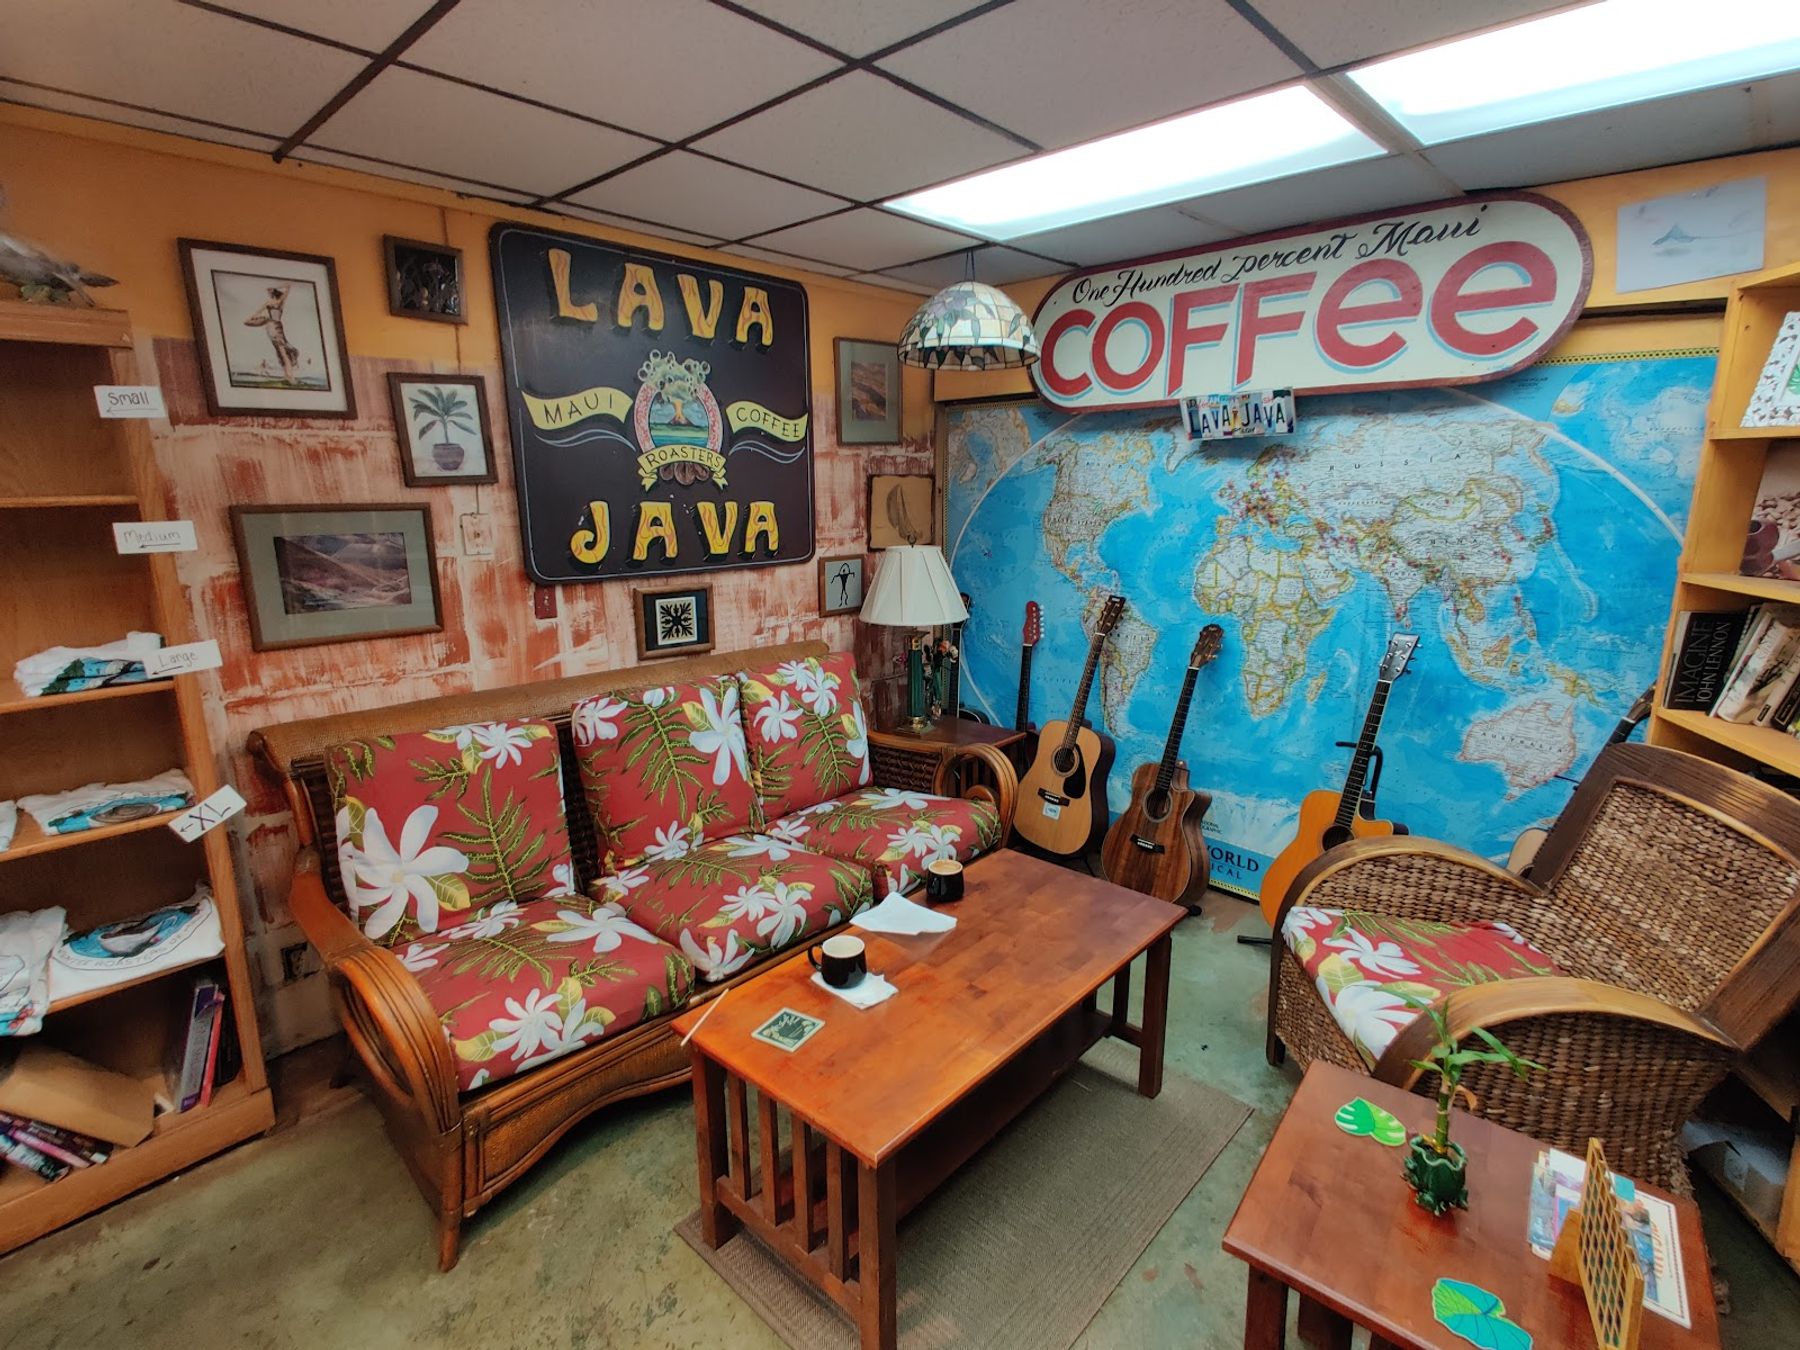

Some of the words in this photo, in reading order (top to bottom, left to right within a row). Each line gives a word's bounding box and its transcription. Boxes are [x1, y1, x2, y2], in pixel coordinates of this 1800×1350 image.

[1072, 271, 1114, 303] One
[1104, 257, 1222, 306] Hundred
[1220, 232, 1358, 285] percent
[1356, 204, 1489, 259] Maui
[548, 248, 775, 348] LAVA
[107, 391, 150, 406] Small
[543, 395, 613, 425] MAUI
[735, 406, 802, 438] COFFEE
[1188, 404, 1231, 434] LAVA
[1241, 402, 1285, 429] JAVA
[645, 447, 723, 467] ROASTERS
[570, 500, 780, 565] JAVA
[158, 651, 199, 668] Large
[1675, 618, 1712, 704] IMAGINE
[1704, 621, 1733, 671] LENNON
[188, 803, 231, 831] XL
